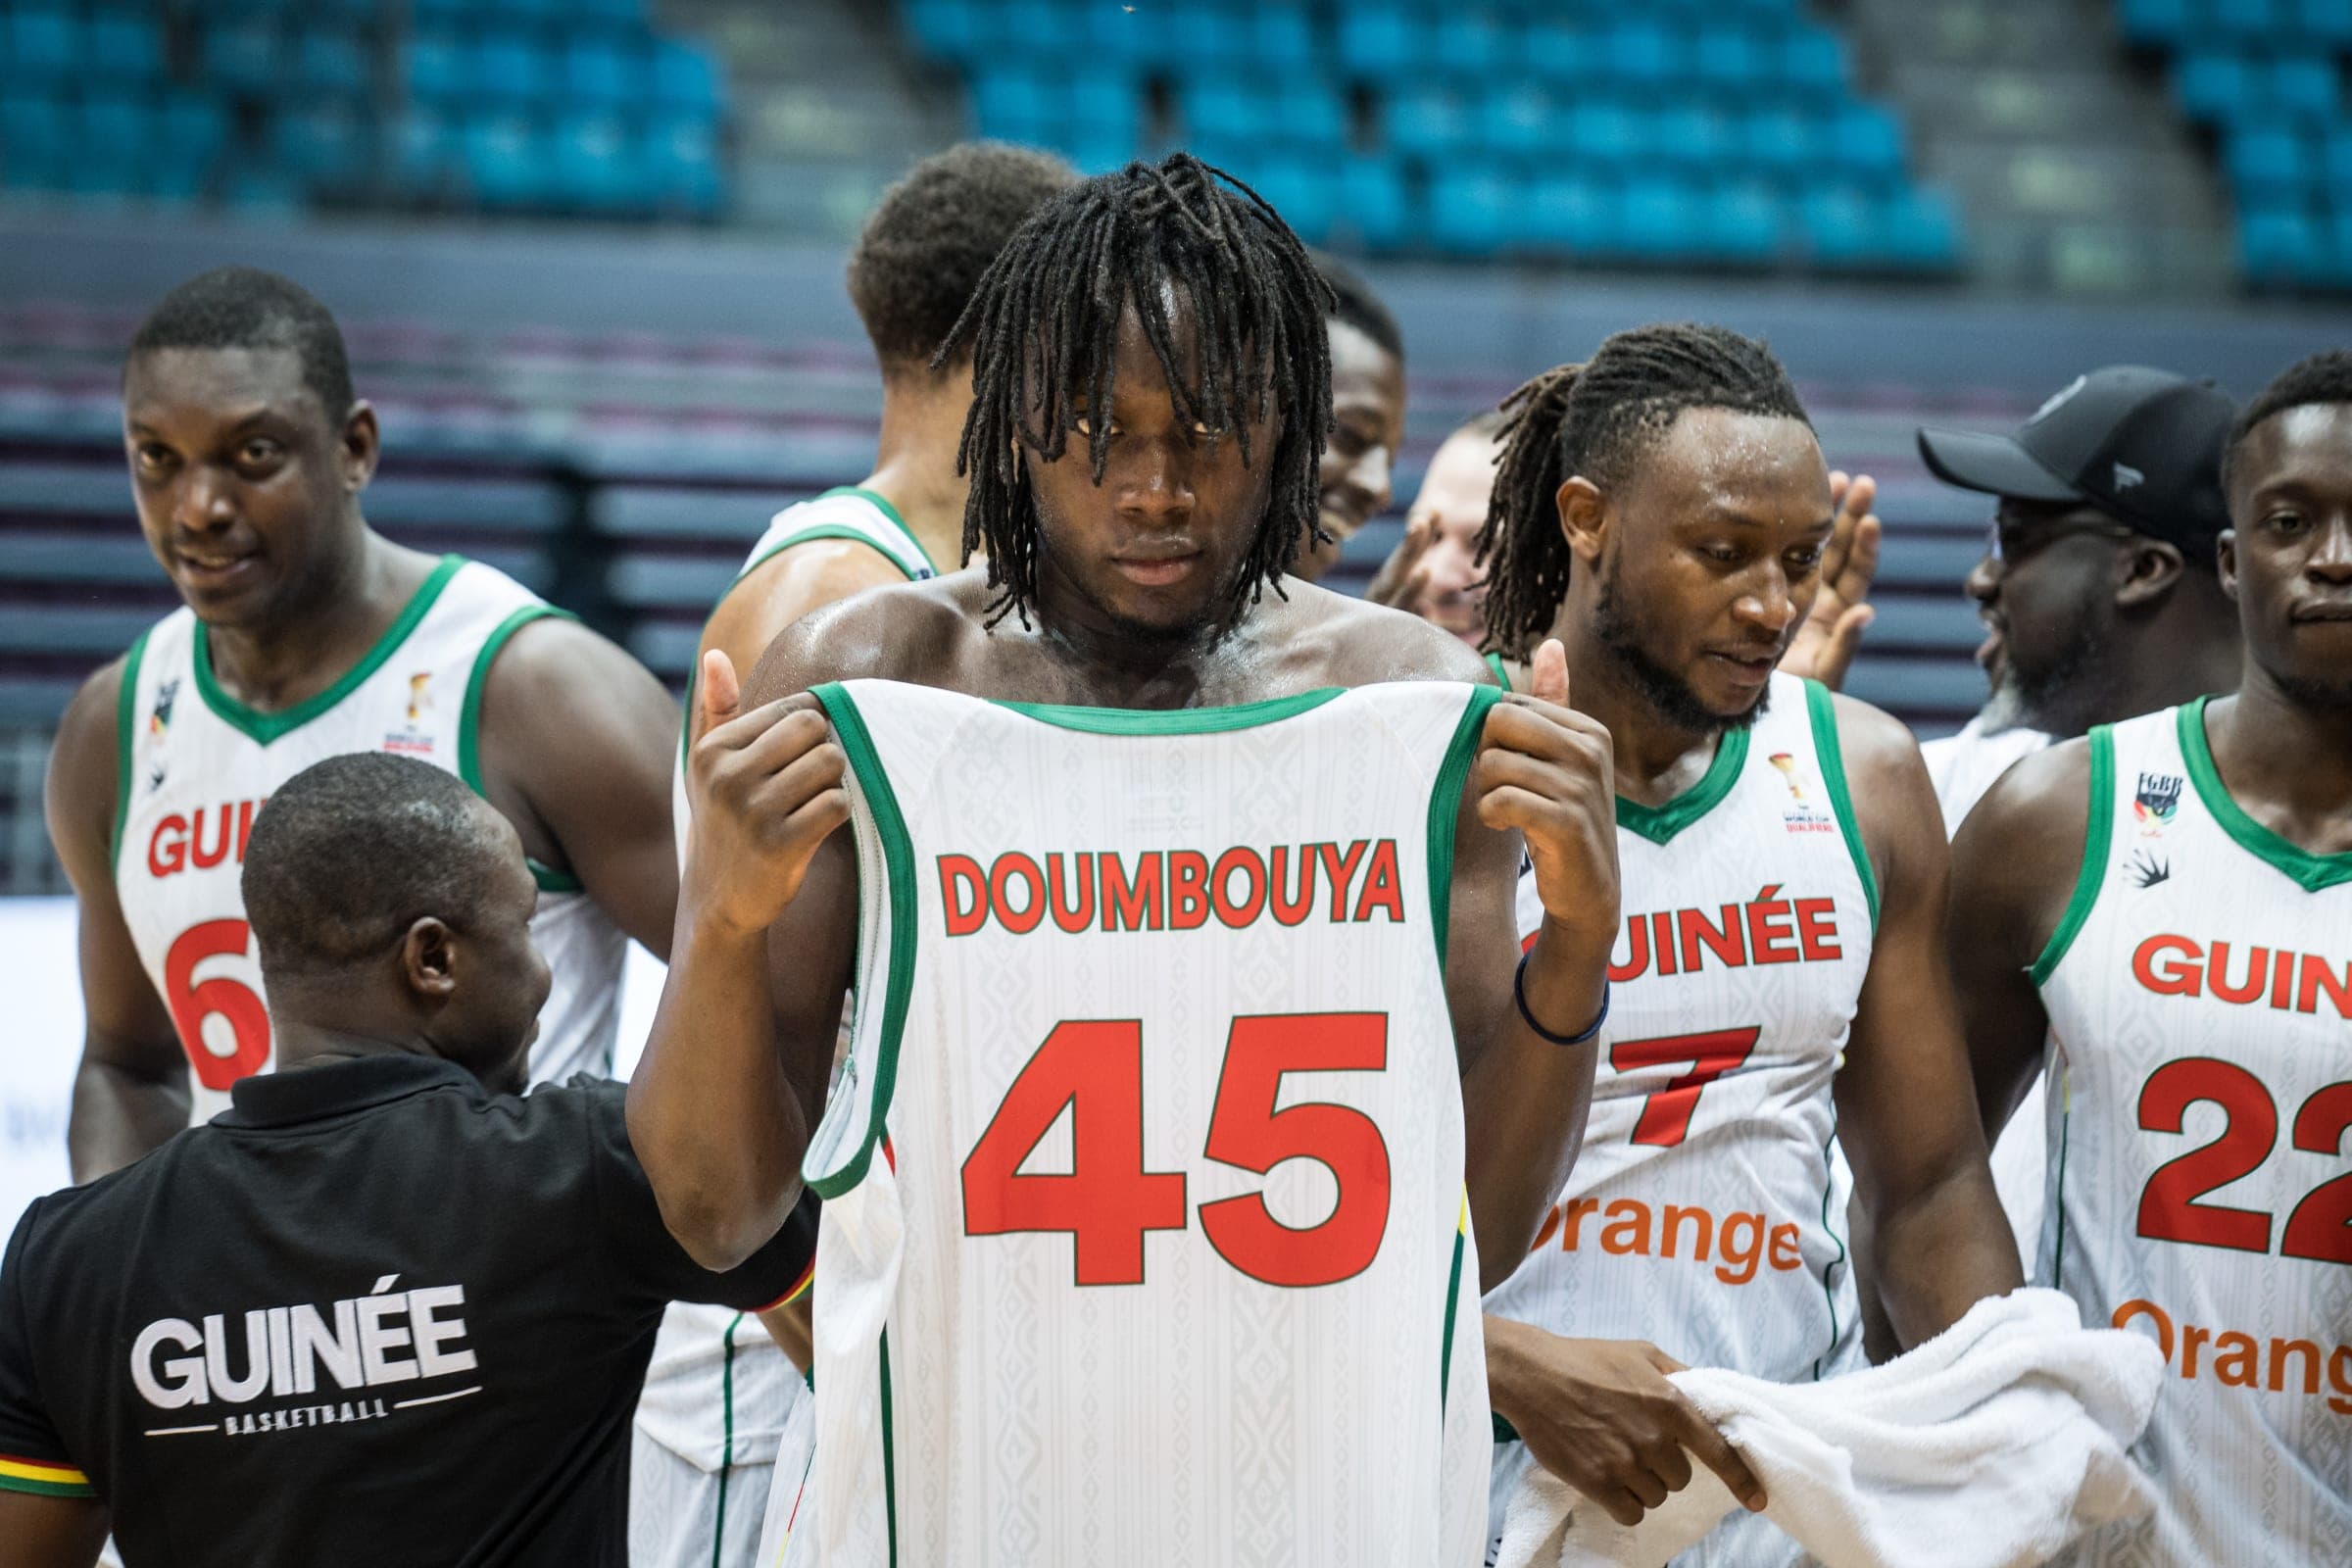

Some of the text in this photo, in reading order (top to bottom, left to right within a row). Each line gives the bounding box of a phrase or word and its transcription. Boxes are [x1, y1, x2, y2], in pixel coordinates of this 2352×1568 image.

[148, 799, 267, 878] GUI
[936, 839, 1405, 937] DOUMBOUYA
[1521, 883, 1843, 983] UINÉE
[165, 918, 271, 1093] 6
[1609, 1025, 1761, 1147] 7
[960, 1011, 1392, 1289] 45
[1530, 1197, 1802, 1285] range
[130, 1273, 478, 1409] GUINÉE
[224, 1397, 389, 1436] BASKETBALL
